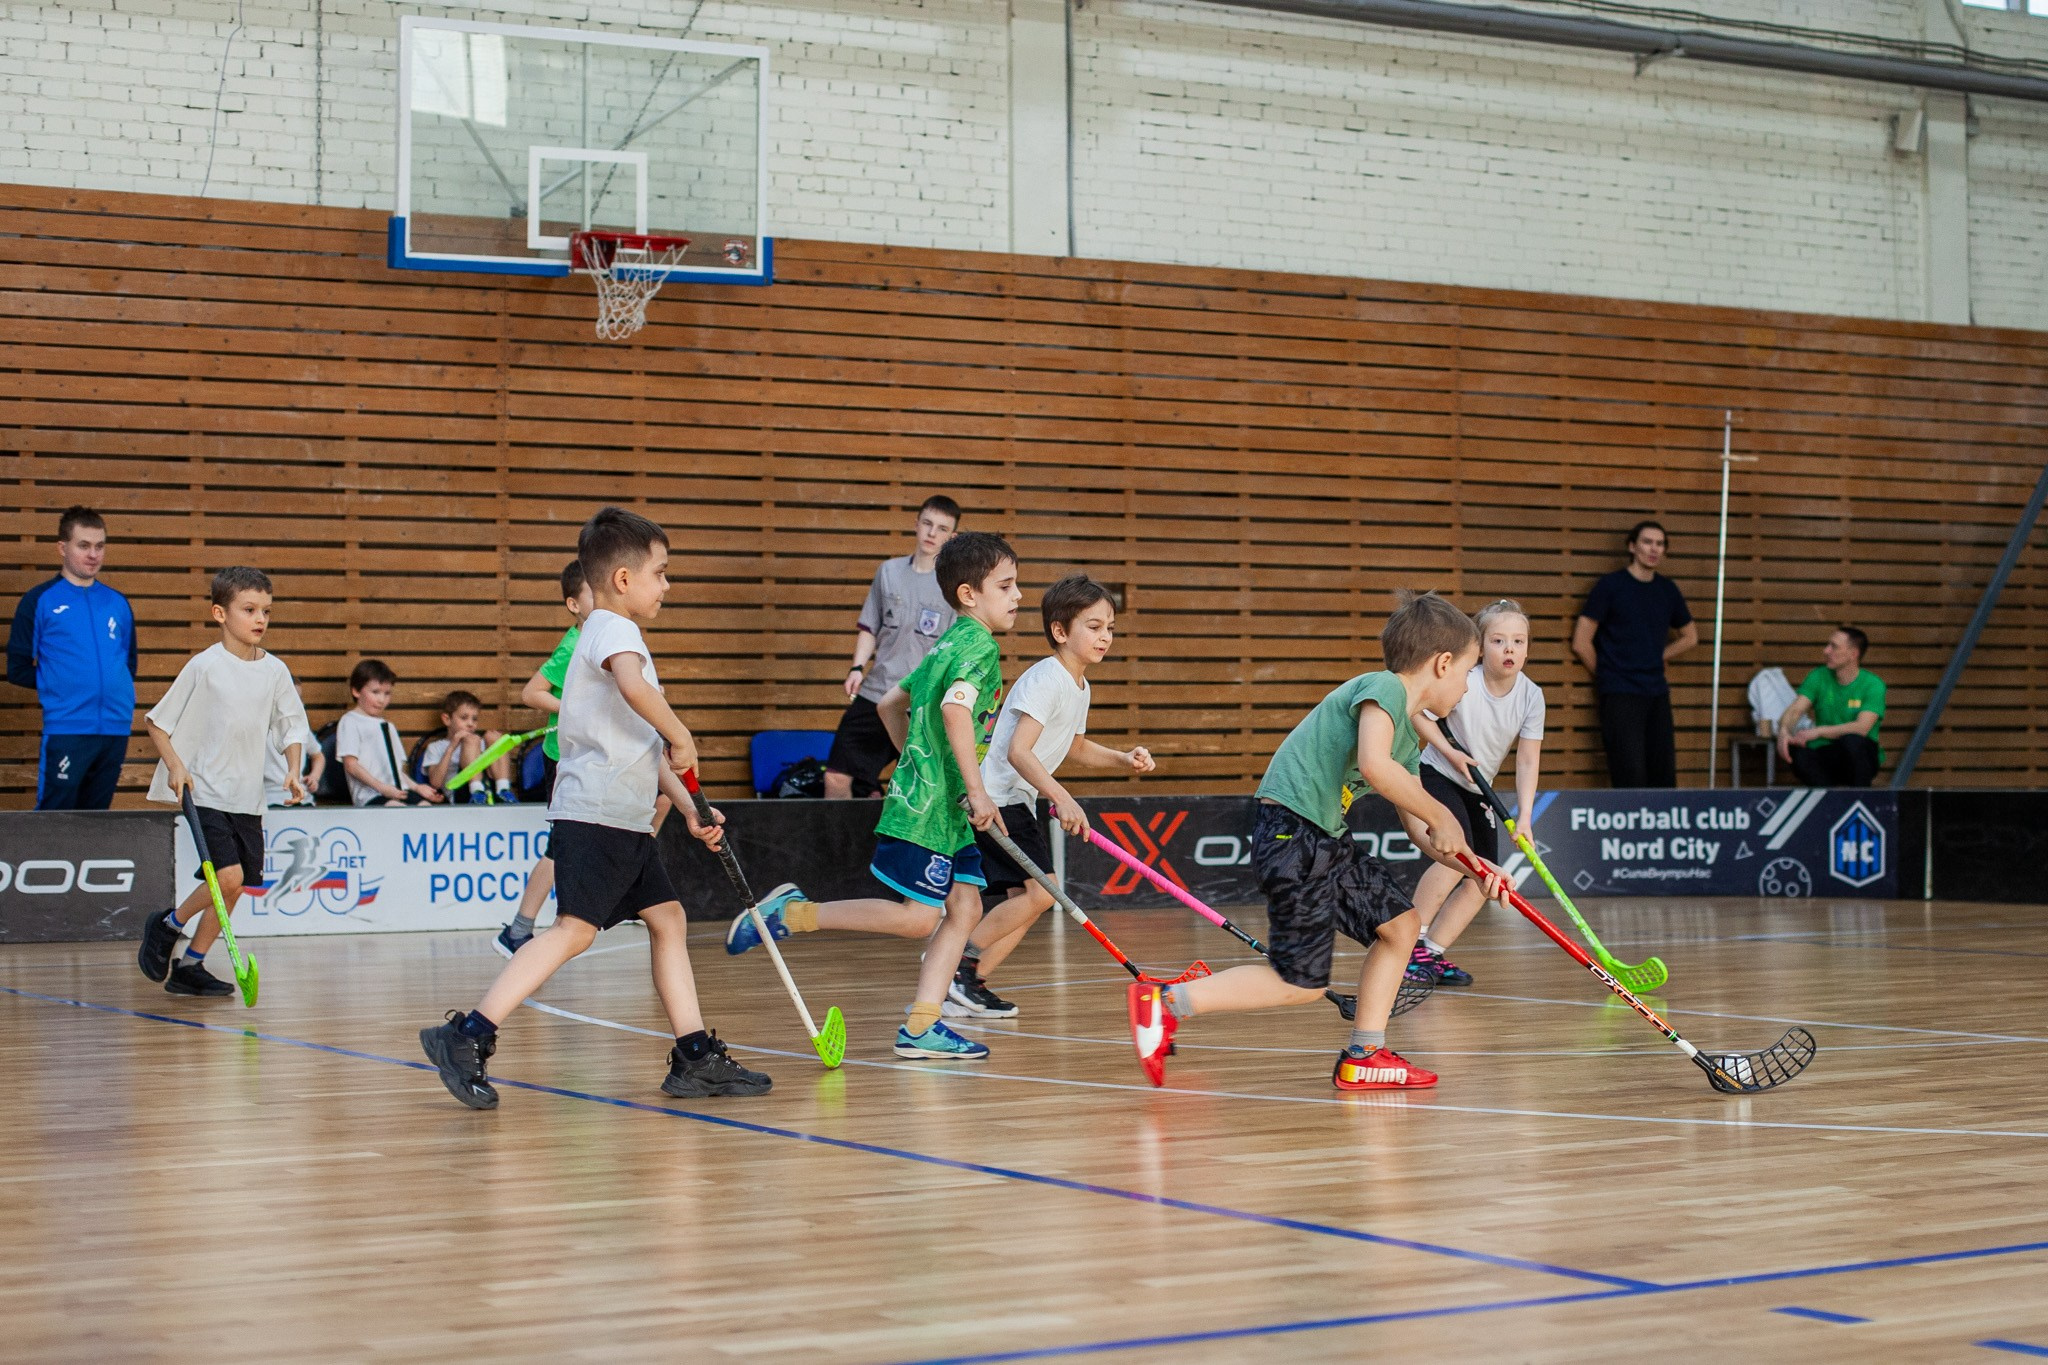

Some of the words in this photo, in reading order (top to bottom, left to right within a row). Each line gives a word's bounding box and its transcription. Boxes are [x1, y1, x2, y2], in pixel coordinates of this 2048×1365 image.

[1571, 807, 1691, 830] Floorball
[1696, 807, 1750, 830] club
[402, 831, 550, 863] МИНСПО
[1602, 837, 1664, 860] Nord
[1670, 837, 1720, 865] City
[338, 856, 367, 868] ЛЕТ
[0, 860, 135, 894] OG
[430, 872, 556, 903] РОСС
